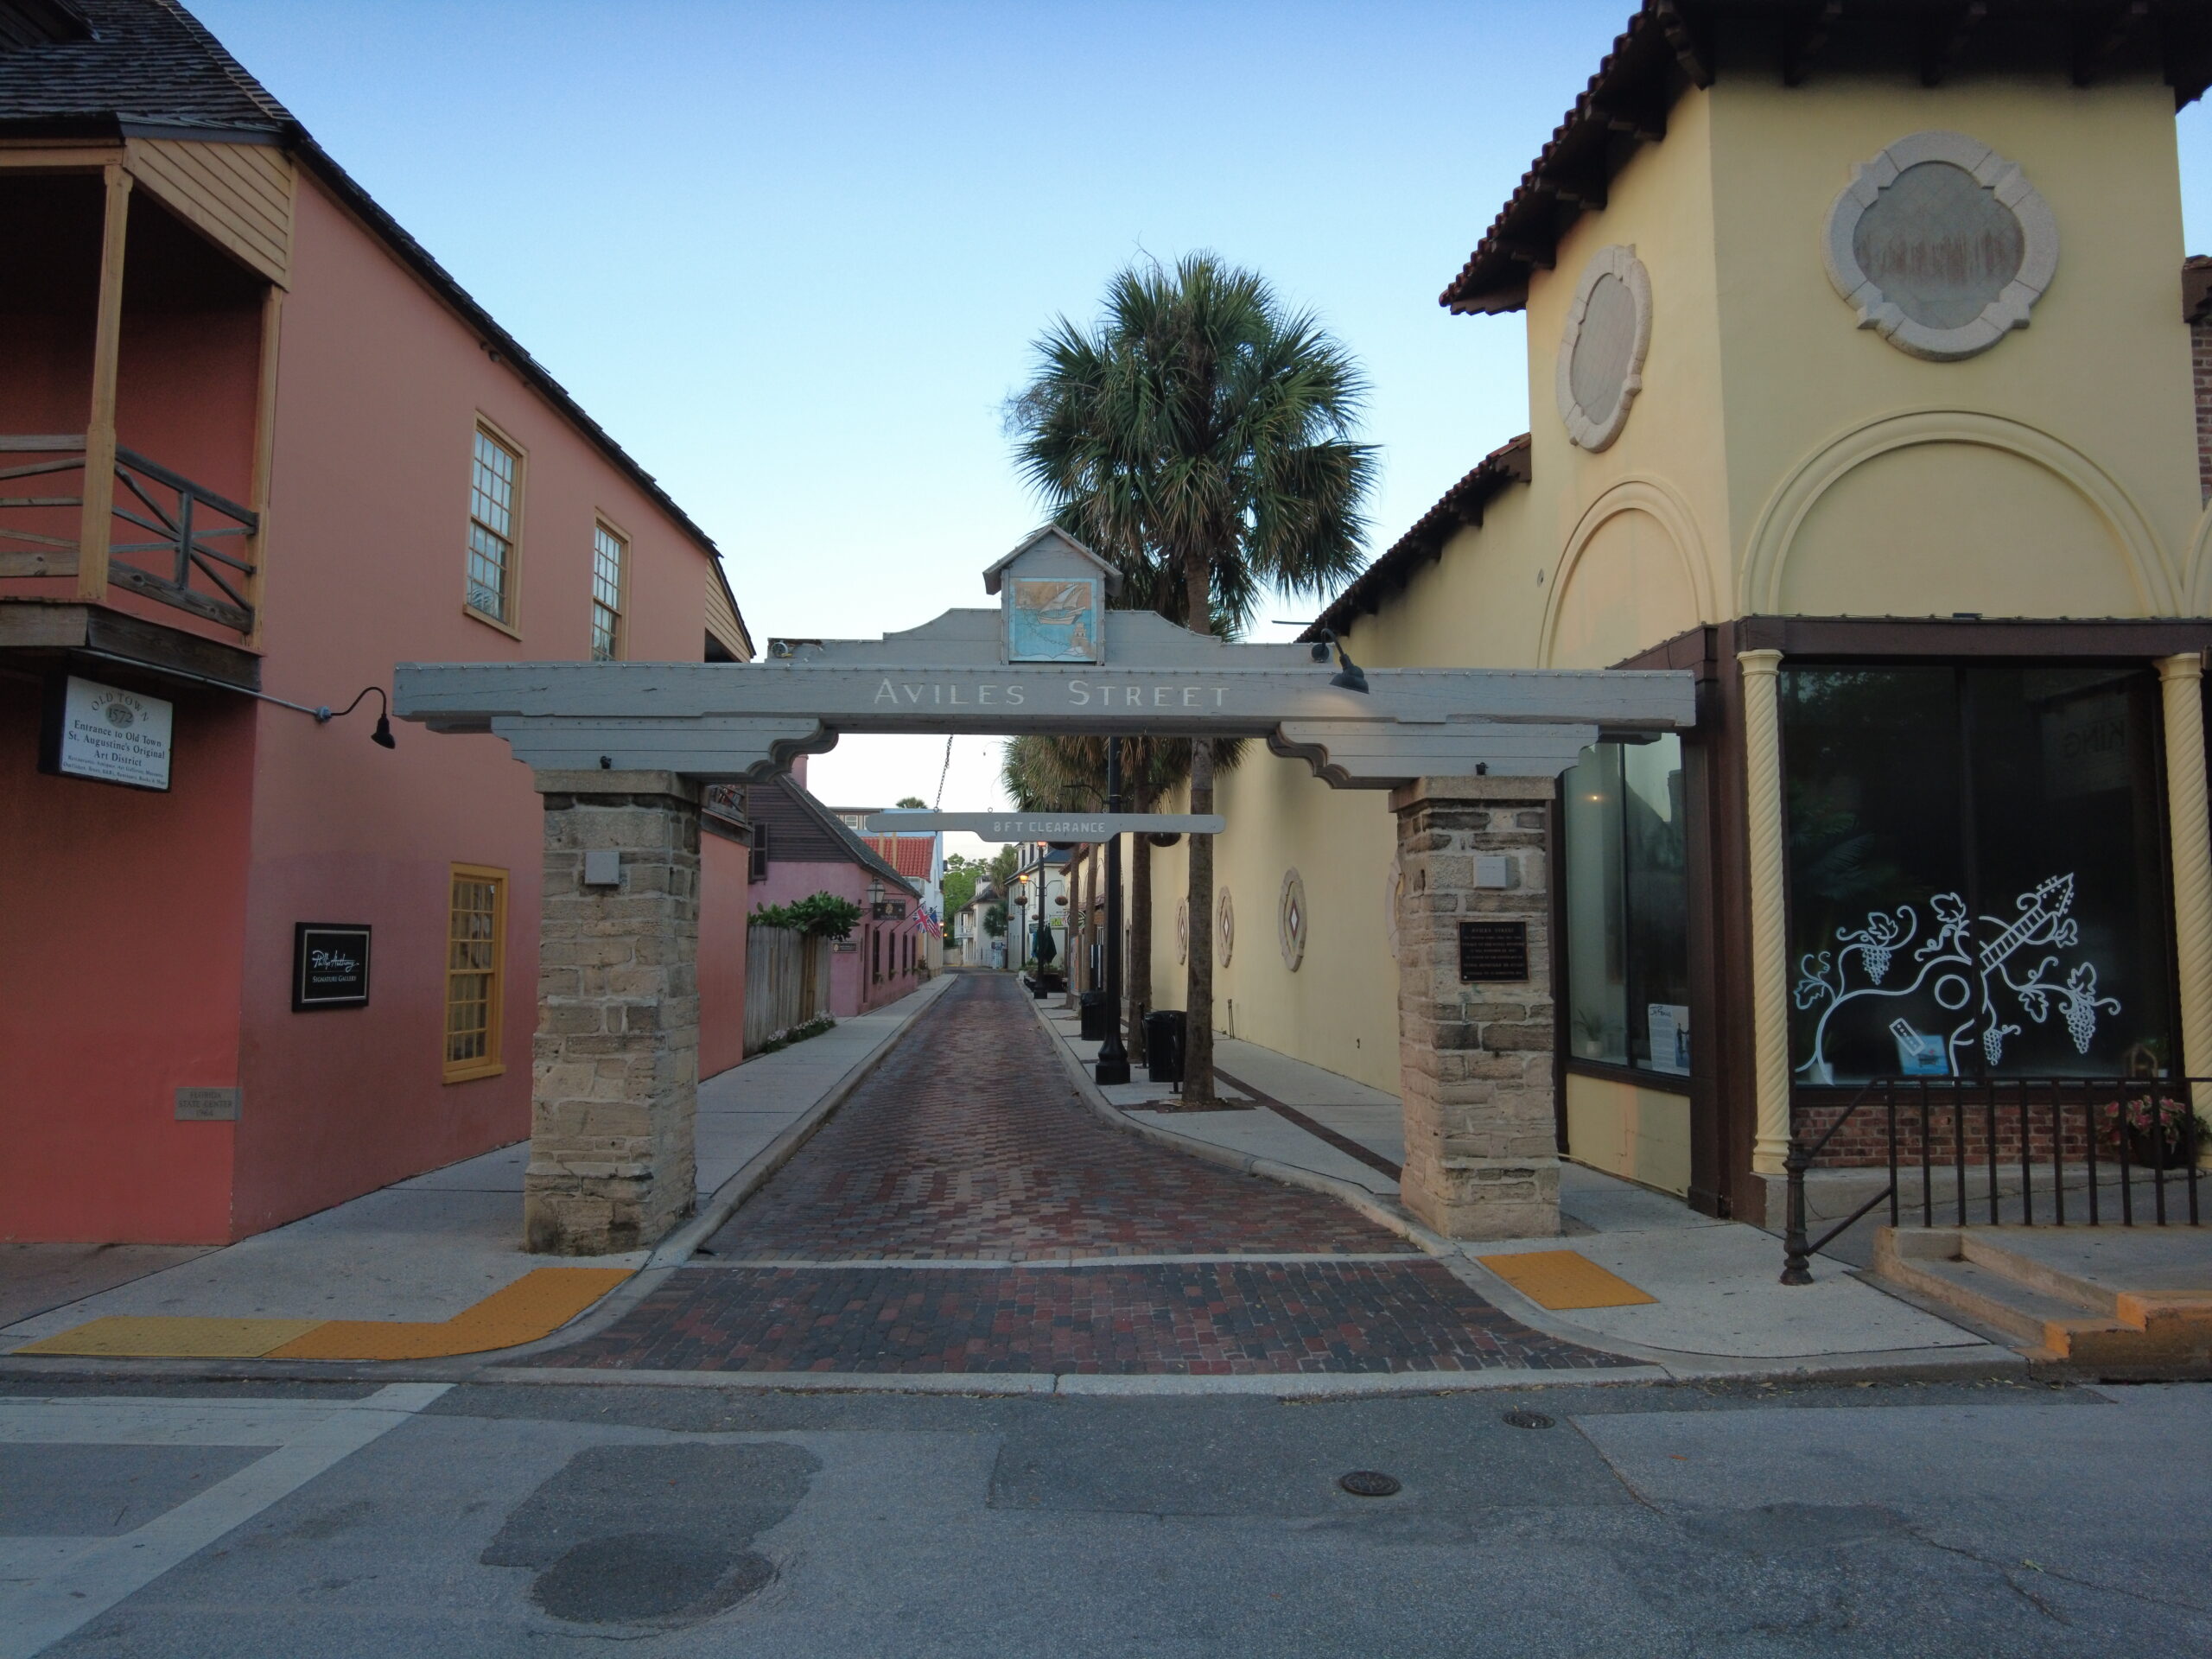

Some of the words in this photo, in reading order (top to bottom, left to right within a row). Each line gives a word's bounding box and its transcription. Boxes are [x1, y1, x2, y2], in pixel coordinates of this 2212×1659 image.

[91, 691, 113, 711] OLD
[118, 692, 149, 721] TOWN
[874, 677, 1025, 706] AVILES
[1068, 679, 1230, 708] STREET
[108, 708, 134, 723] 1572
[68, 731, 79, 741] St.
[84, 734, 130, 751] Augustine's
[133, 745, 165, 760] Original
[74, 719, 111, 736] Entrance
[115, 730, 123, 739] to
[126, 731, 139, 742] Old
[143, 735, 162, 747] Town
[95, 749, 109, 760] Art
[111, 753, 142, 766] District
[1029, 822, 1106, 833] CLEARANCE
